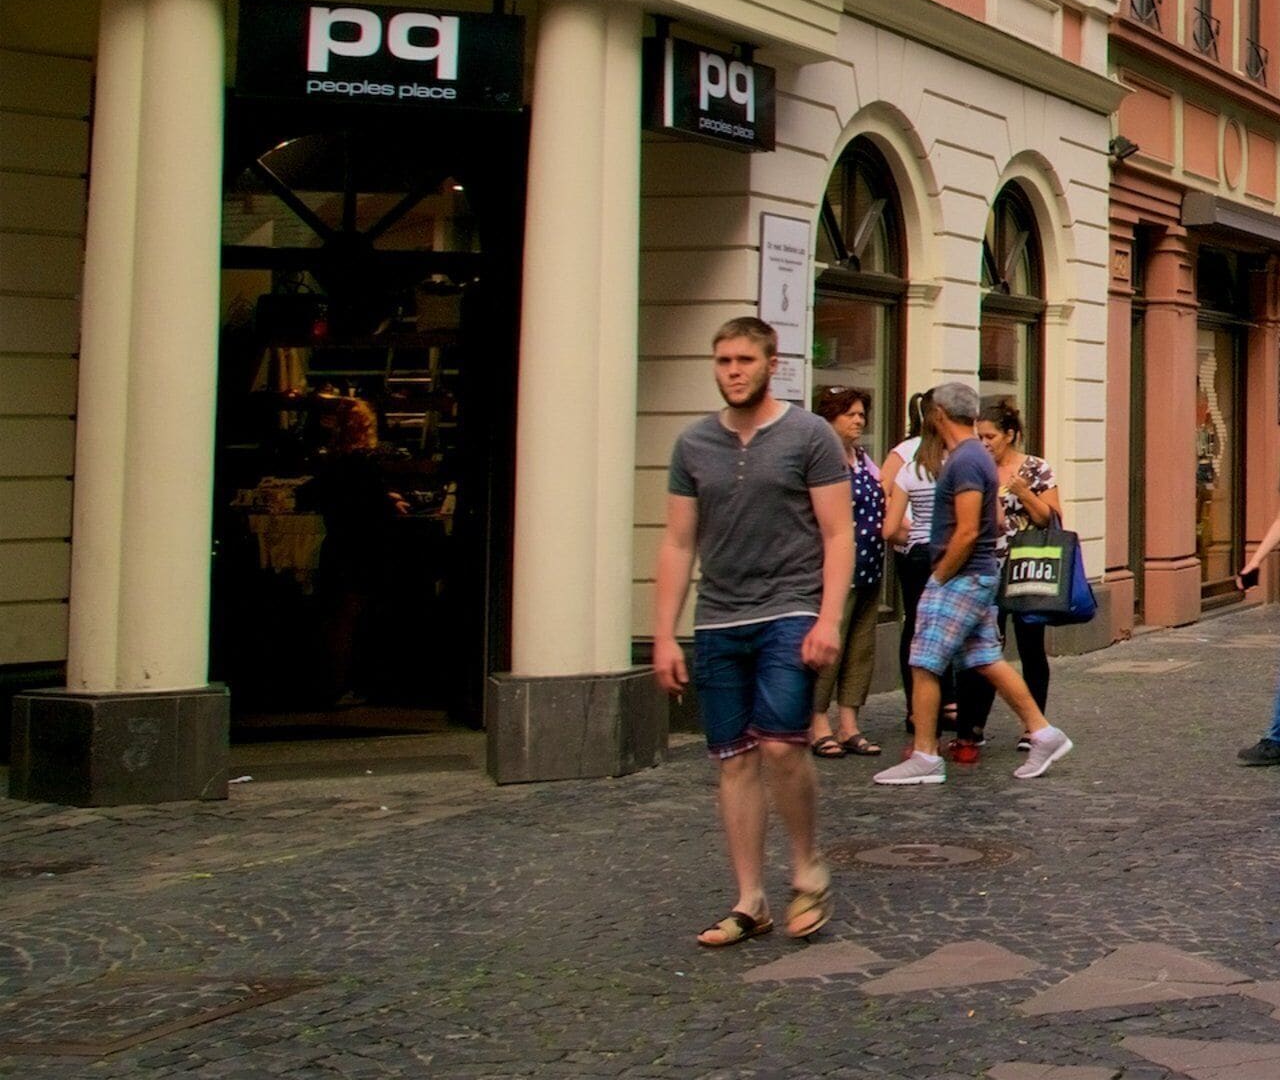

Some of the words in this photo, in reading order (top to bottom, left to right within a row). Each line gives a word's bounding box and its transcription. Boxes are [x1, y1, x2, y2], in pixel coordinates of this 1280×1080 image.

[306, 5, 461, 81] pq
[306, 78, 395, 99] peoples
[399, 81, 457, 100] place
[699, 50, 755, 123] pq
[699, 117, 731, 136] peoples
[732, 123, 755, 139] place
